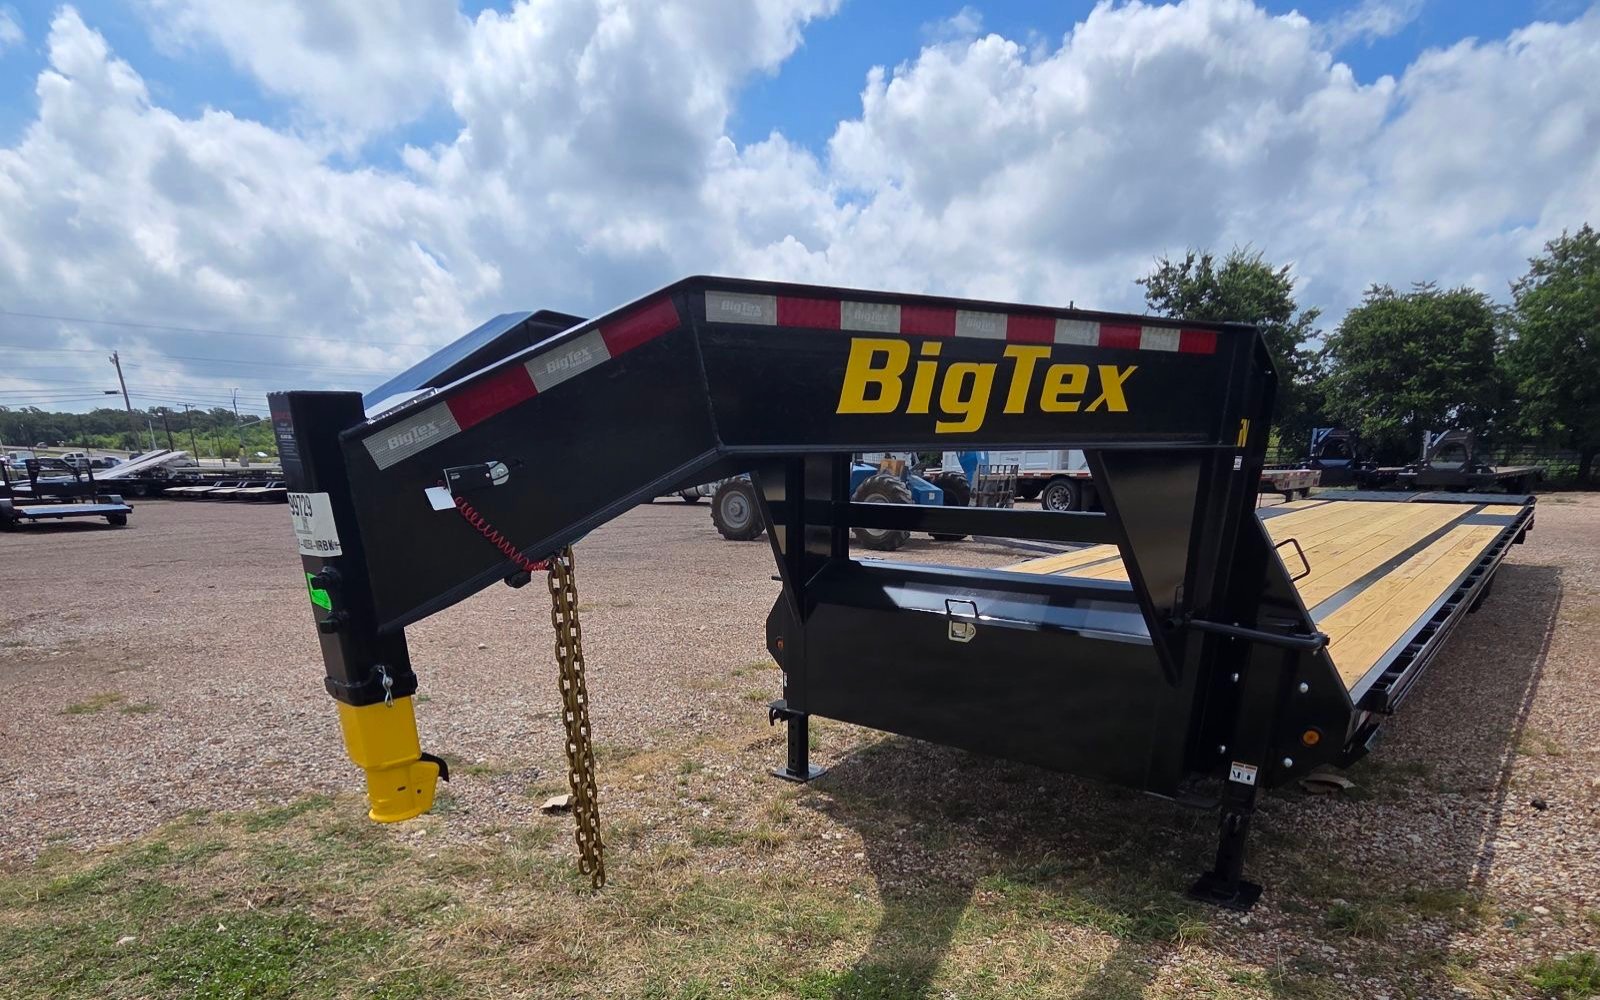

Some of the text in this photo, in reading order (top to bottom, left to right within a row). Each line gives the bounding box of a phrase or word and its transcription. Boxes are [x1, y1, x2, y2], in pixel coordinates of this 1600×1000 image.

[546, 346, 589, 374] BigTex
[836, 337, 1138, 433] BigTex
[388, 421, 440, 449] BigTex
